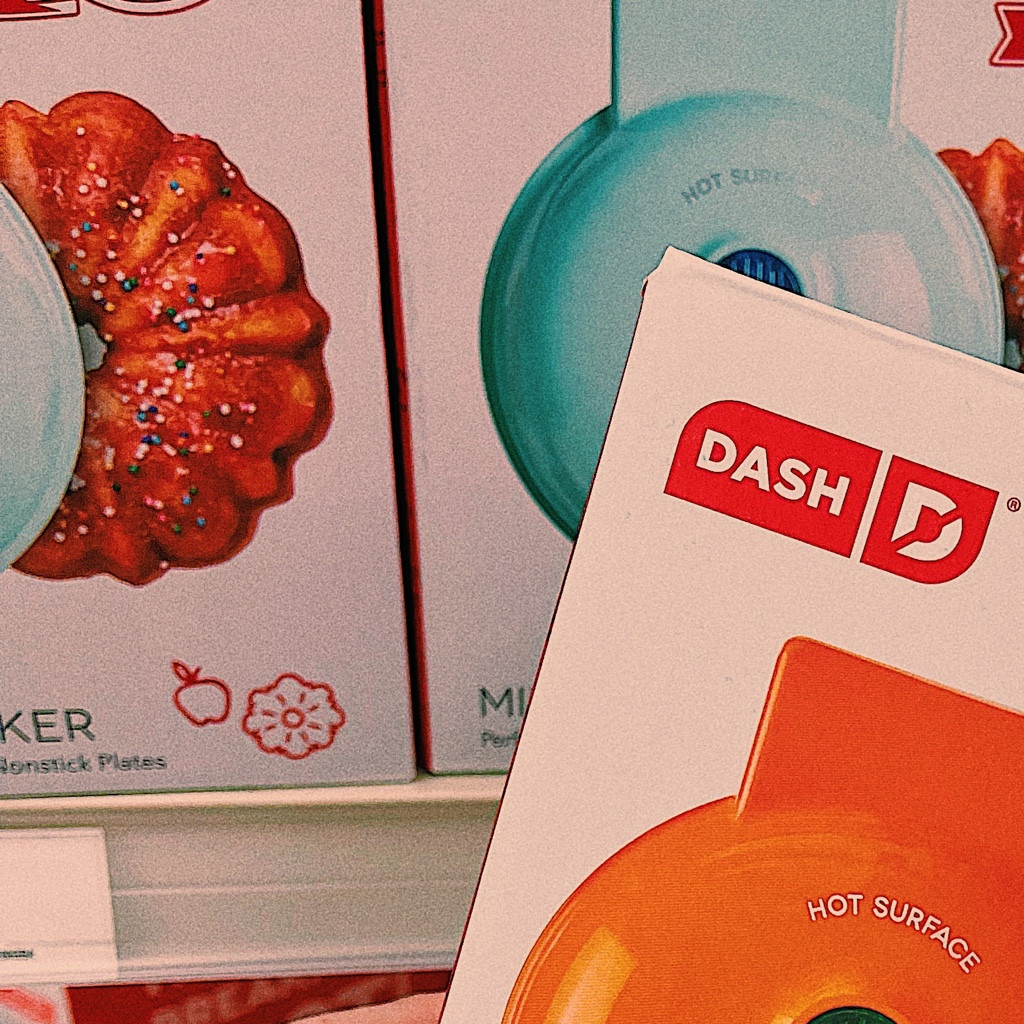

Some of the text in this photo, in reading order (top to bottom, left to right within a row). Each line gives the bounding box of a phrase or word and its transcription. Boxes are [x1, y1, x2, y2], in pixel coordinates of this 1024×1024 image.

[681, 172, 723, 205] HOT
[696, 428, 851, 517] DASH
[98, 752, 168, 772] Plates
[806, 893, 982, 975] HOT SURFACE
